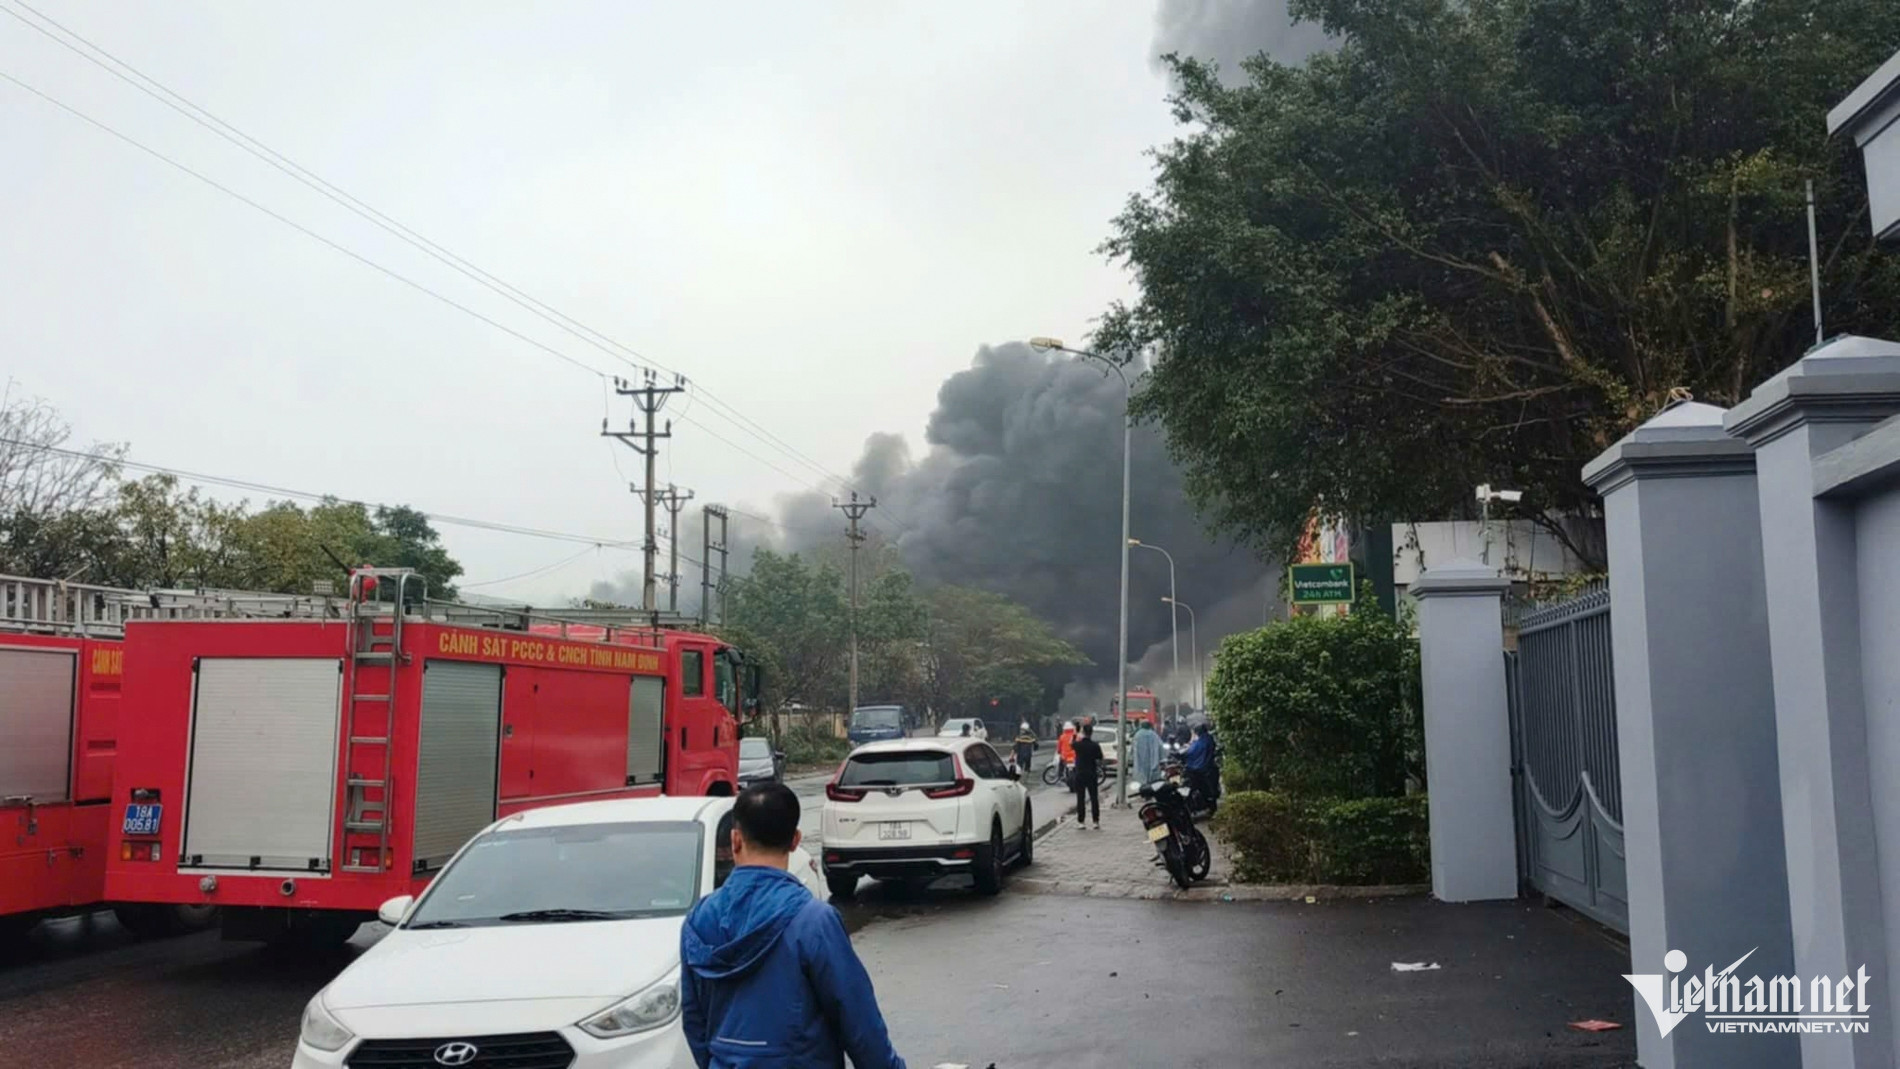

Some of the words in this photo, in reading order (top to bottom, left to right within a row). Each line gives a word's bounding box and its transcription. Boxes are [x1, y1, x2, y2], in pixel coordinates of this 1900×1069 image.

[1294, 579, 1349, 589] Vietcombank
[1323, 590, 1342, 598] ATM
[440, 629, 478, 655] CẢNH
[482, 634, 507, 657] SÁT
[512, 640, 544, 661] PCCC
[546, 644, 555, 661] &
[559, 645, 587, 665] CNCH
[614, 651, 636, 669] NAM
[136, 805, 153, 818] 18A
